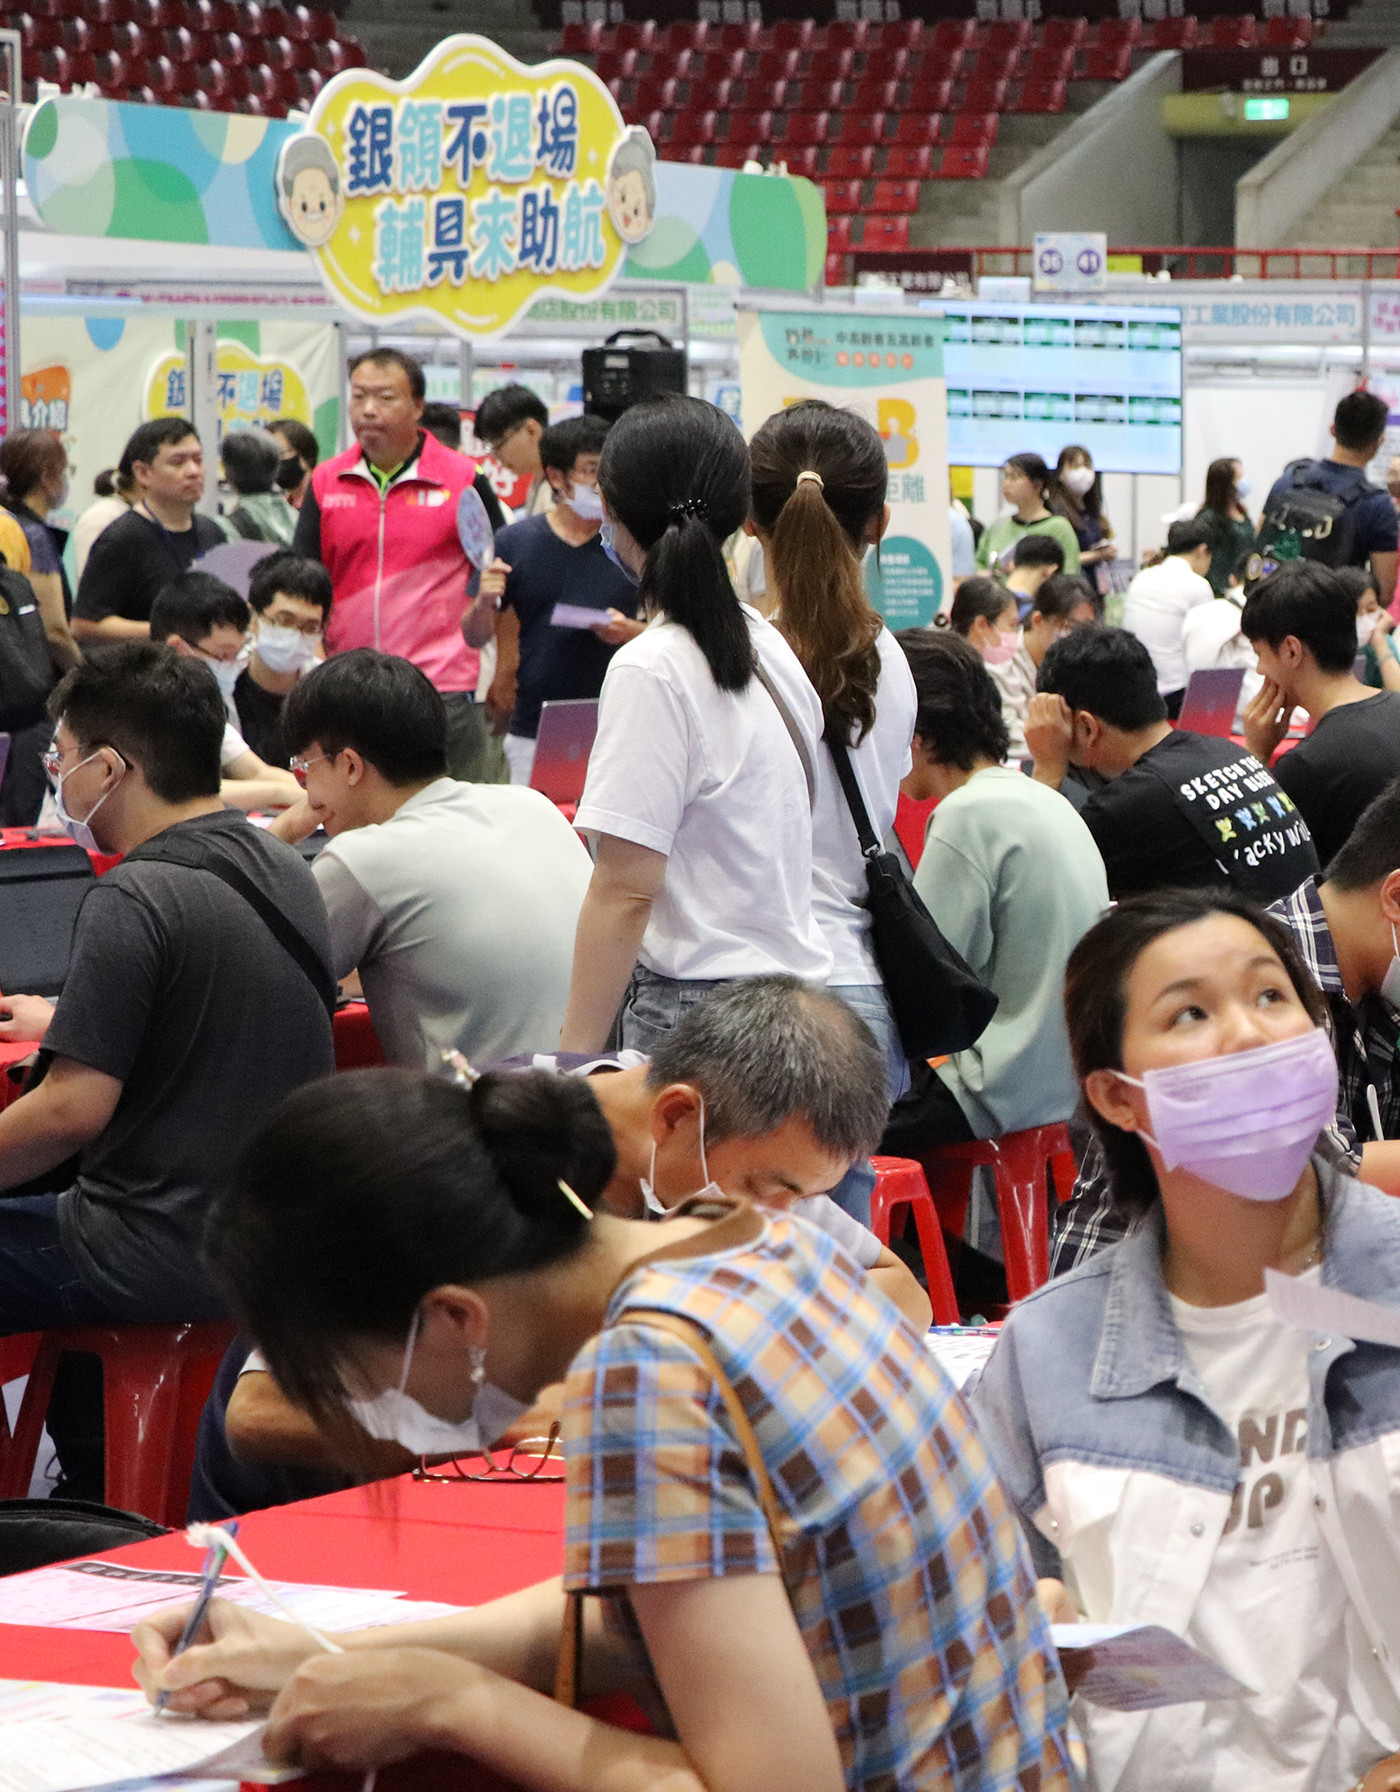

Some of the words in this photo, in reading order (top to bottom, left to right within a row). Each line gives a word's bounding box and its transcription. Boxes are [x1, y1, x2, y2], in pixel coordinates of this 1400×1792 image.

[347, 85, 579, 193] 銀領不退場
[373, 181, 606, 291] 輔具來助航
[1183, 304, 1356, 328] 工業股份有限公司
[1180, 762, 1247, 801] SKETCH
[1205, 783, 1244, 811] DAY
